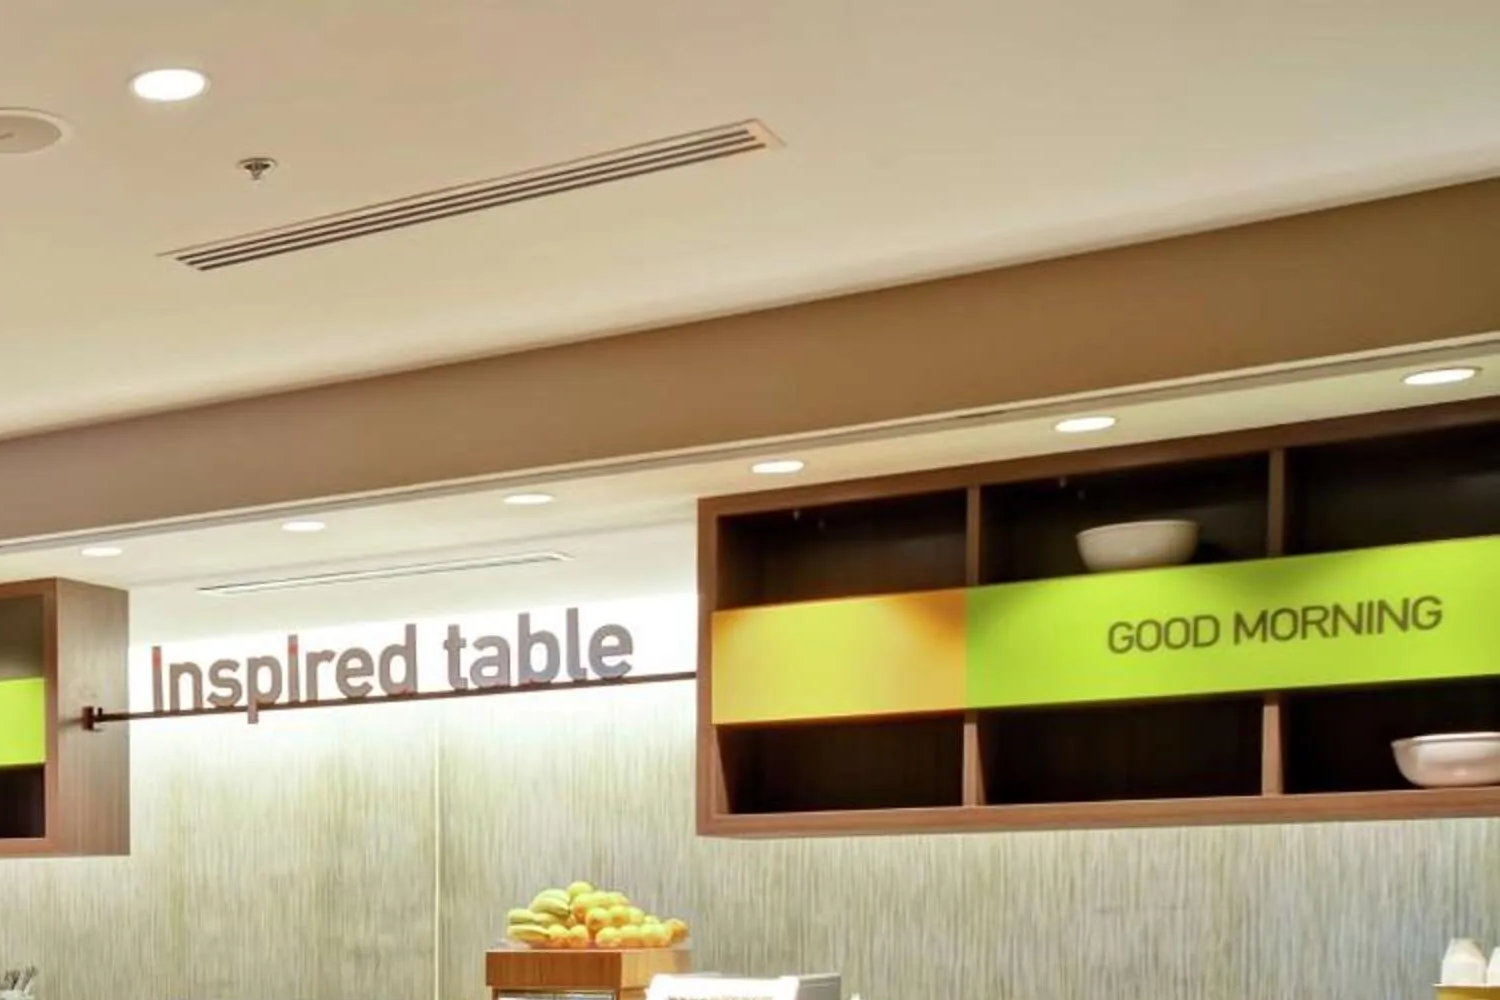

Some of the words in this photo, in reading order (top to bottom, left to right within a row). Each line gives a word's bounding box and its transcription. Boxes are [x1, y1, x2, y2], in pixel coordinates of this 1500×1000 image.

[443, 607, 634, 691] table
[1107, 613, 1221, 655] GOOD
[1233, 595, 1443, 646] MORNING
